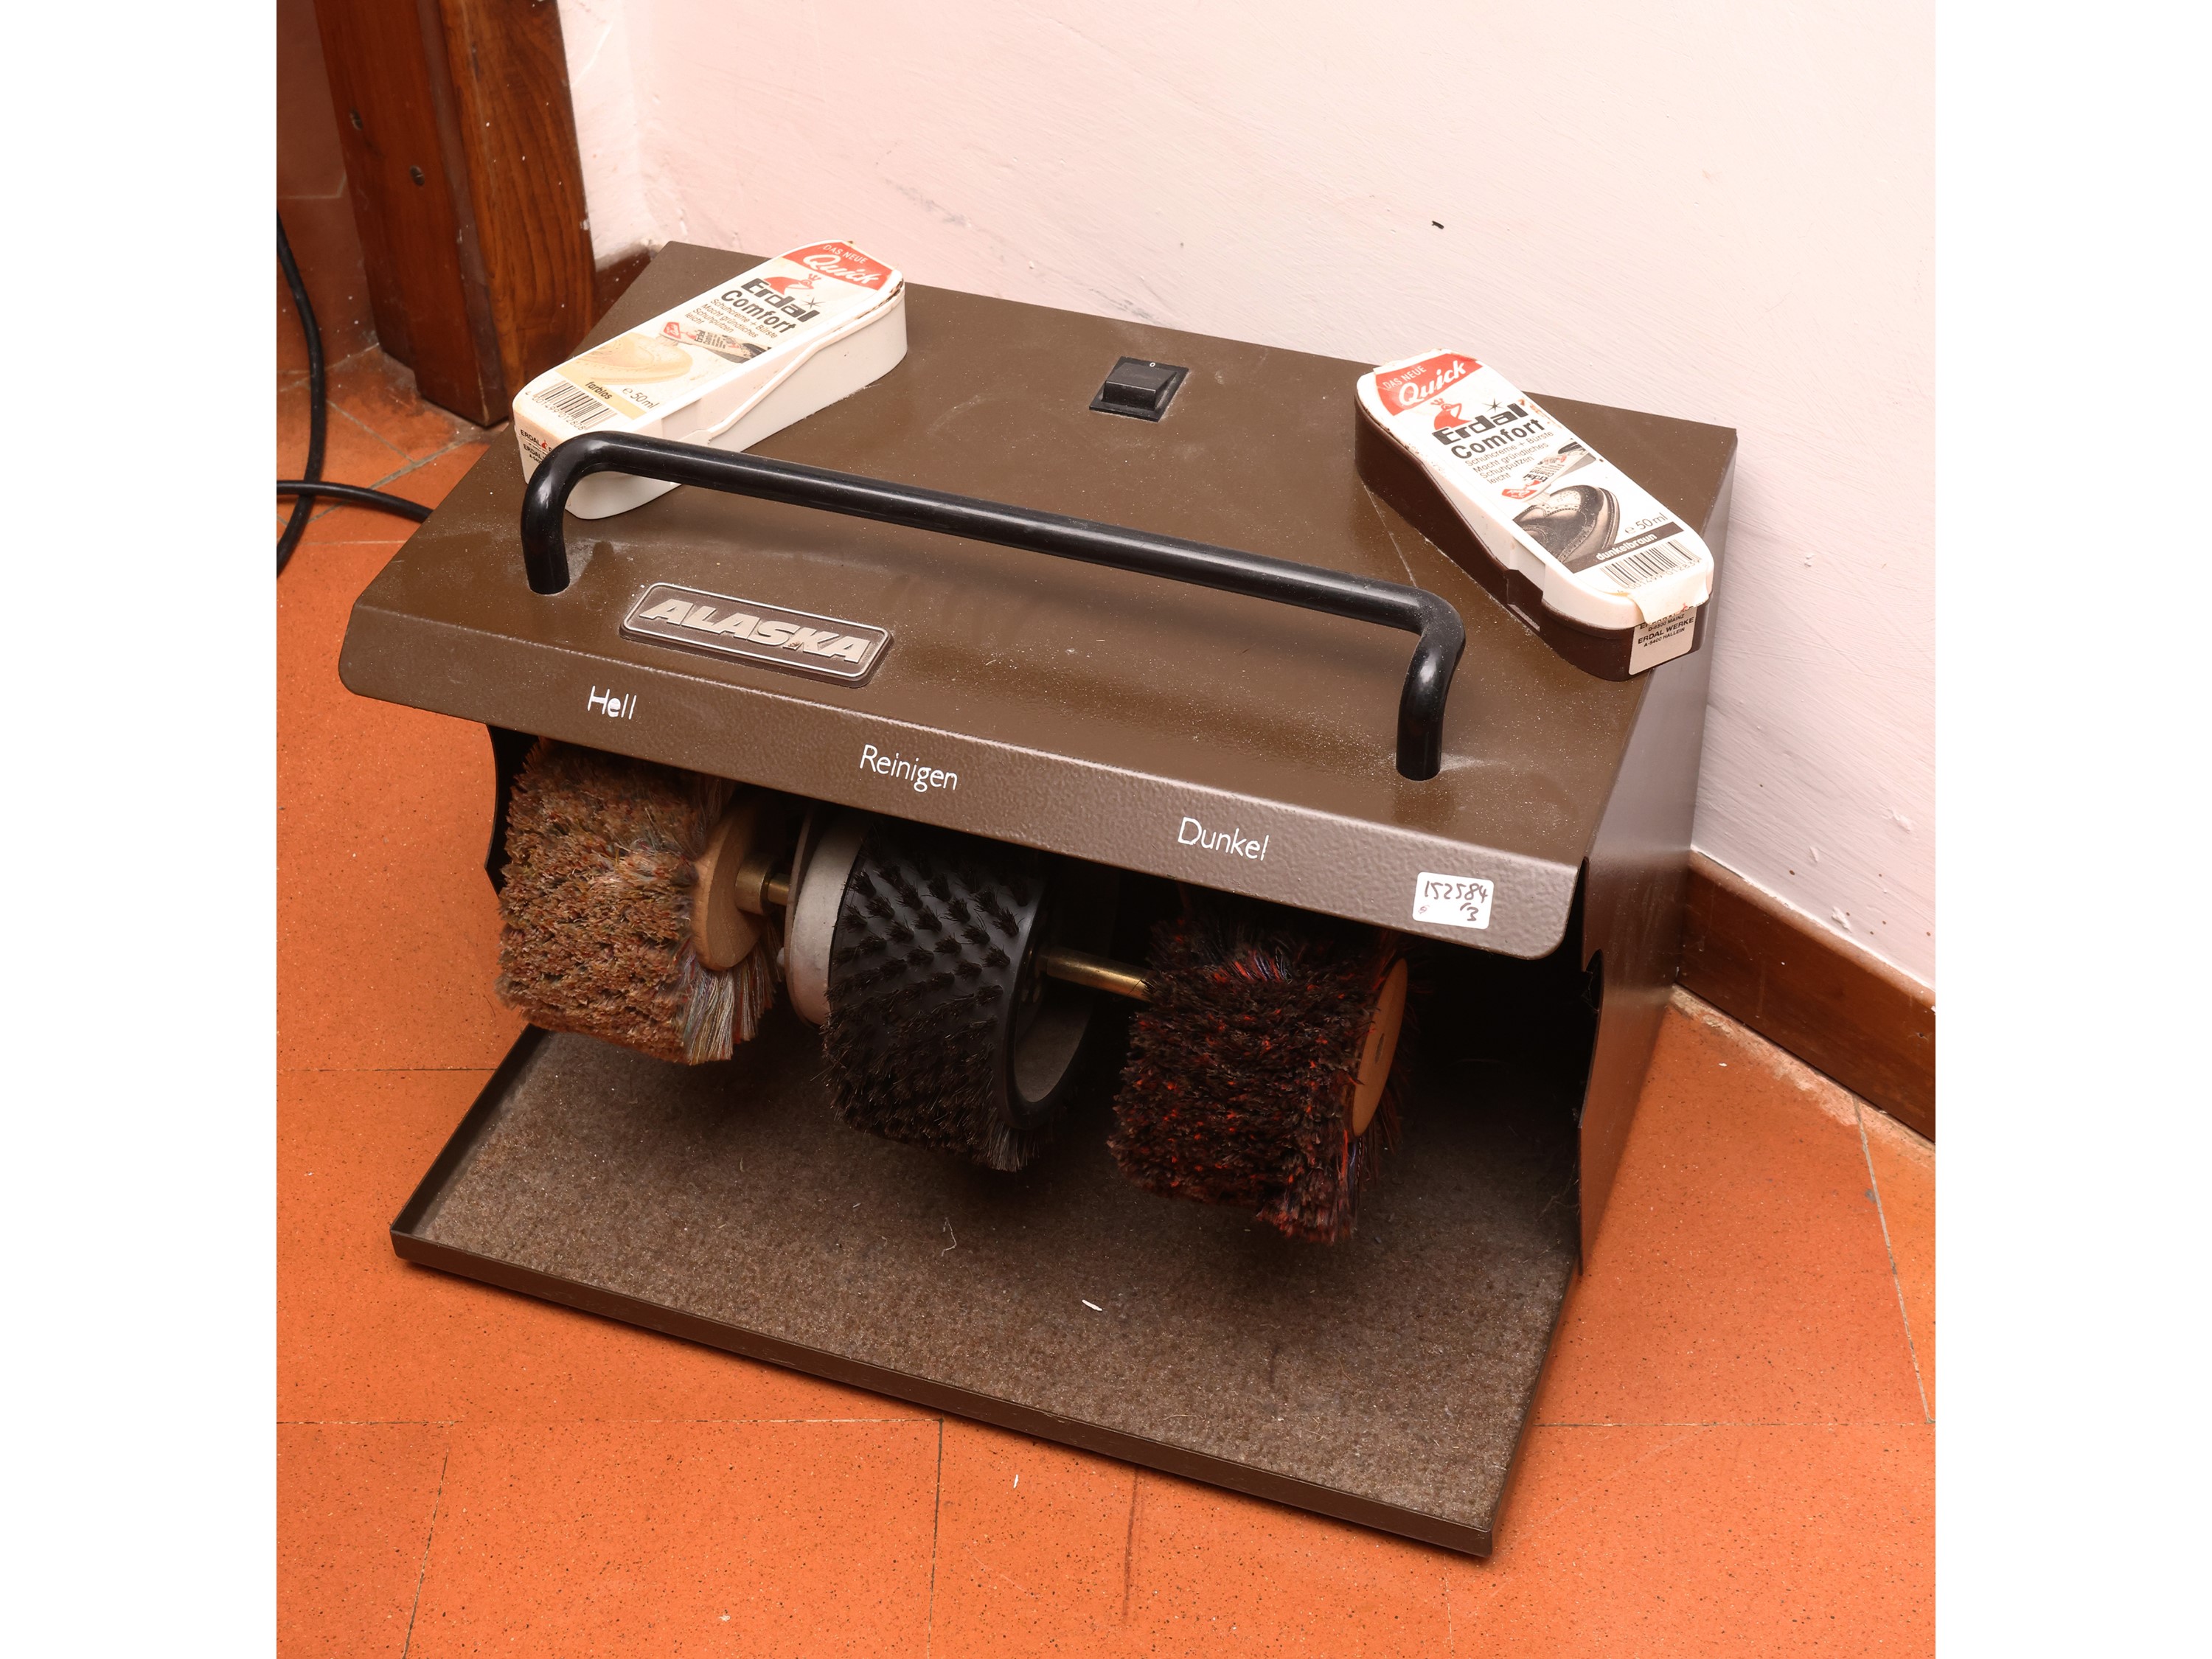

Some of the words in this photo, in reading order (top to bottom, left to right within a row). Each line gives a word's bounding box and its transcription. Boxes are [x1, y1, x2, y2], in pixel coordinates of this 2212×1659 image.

[803, 254, 882, 284] Quick
[823, 244, 844, 255] DAS
[842, 251, 868, 264] NEUE
[721, 290, 796, 333] Comfort
[741, 278, 820, 322] Erdal
[684, 313, 705, 324] leicht
[693, 307, 734, 333] Schuhputzen
[702, 304, 723, 318] Macht
[720, 315, 759, 338] gründliches
[710, 299, 750, 323] Schuhcreme
[756, 324, 778, 338] Bürste
[585, 381, 613, 400] farblos
[1382, 378, 1402, 389] DAS
[1400, 365, 1427, 381] NEUE
[1399, 360, 1466, 406] Quick
[521, 429, 542, 447] ERDAL
[1432, 403, 1528, 445] Erdal
[1451, 419, 1545, 459] Comfort
[1465, 445, 1517, 467] Schuhcreme
[1526, 431, 1554, 444] Bürste
[1472, 459, 1500, 473] Macht
[1501, 442, 1549, 464] gründliches
[1480, 456, 1534, 479] Schuhputzen
[1486, 472, 1512, 484] leicht
[1596, 533, 1658, 560] dunkelbraun
[639, 598, 872, 664] ALASKA
[1638, 630, 1664, 644] ERDAL
[1666, 616, 1694, 633] WERKE
[1663, 627, 1685, 640] HALLEIN
[1667, 613, 1685, 624] MAINZ
[587, 686, 637, 720] Hell
[860, 744, 958, 793] Reinigen
[1178, 816, 1270, 861] Dunkel
[1424, 880, 1489, 903] 152584
